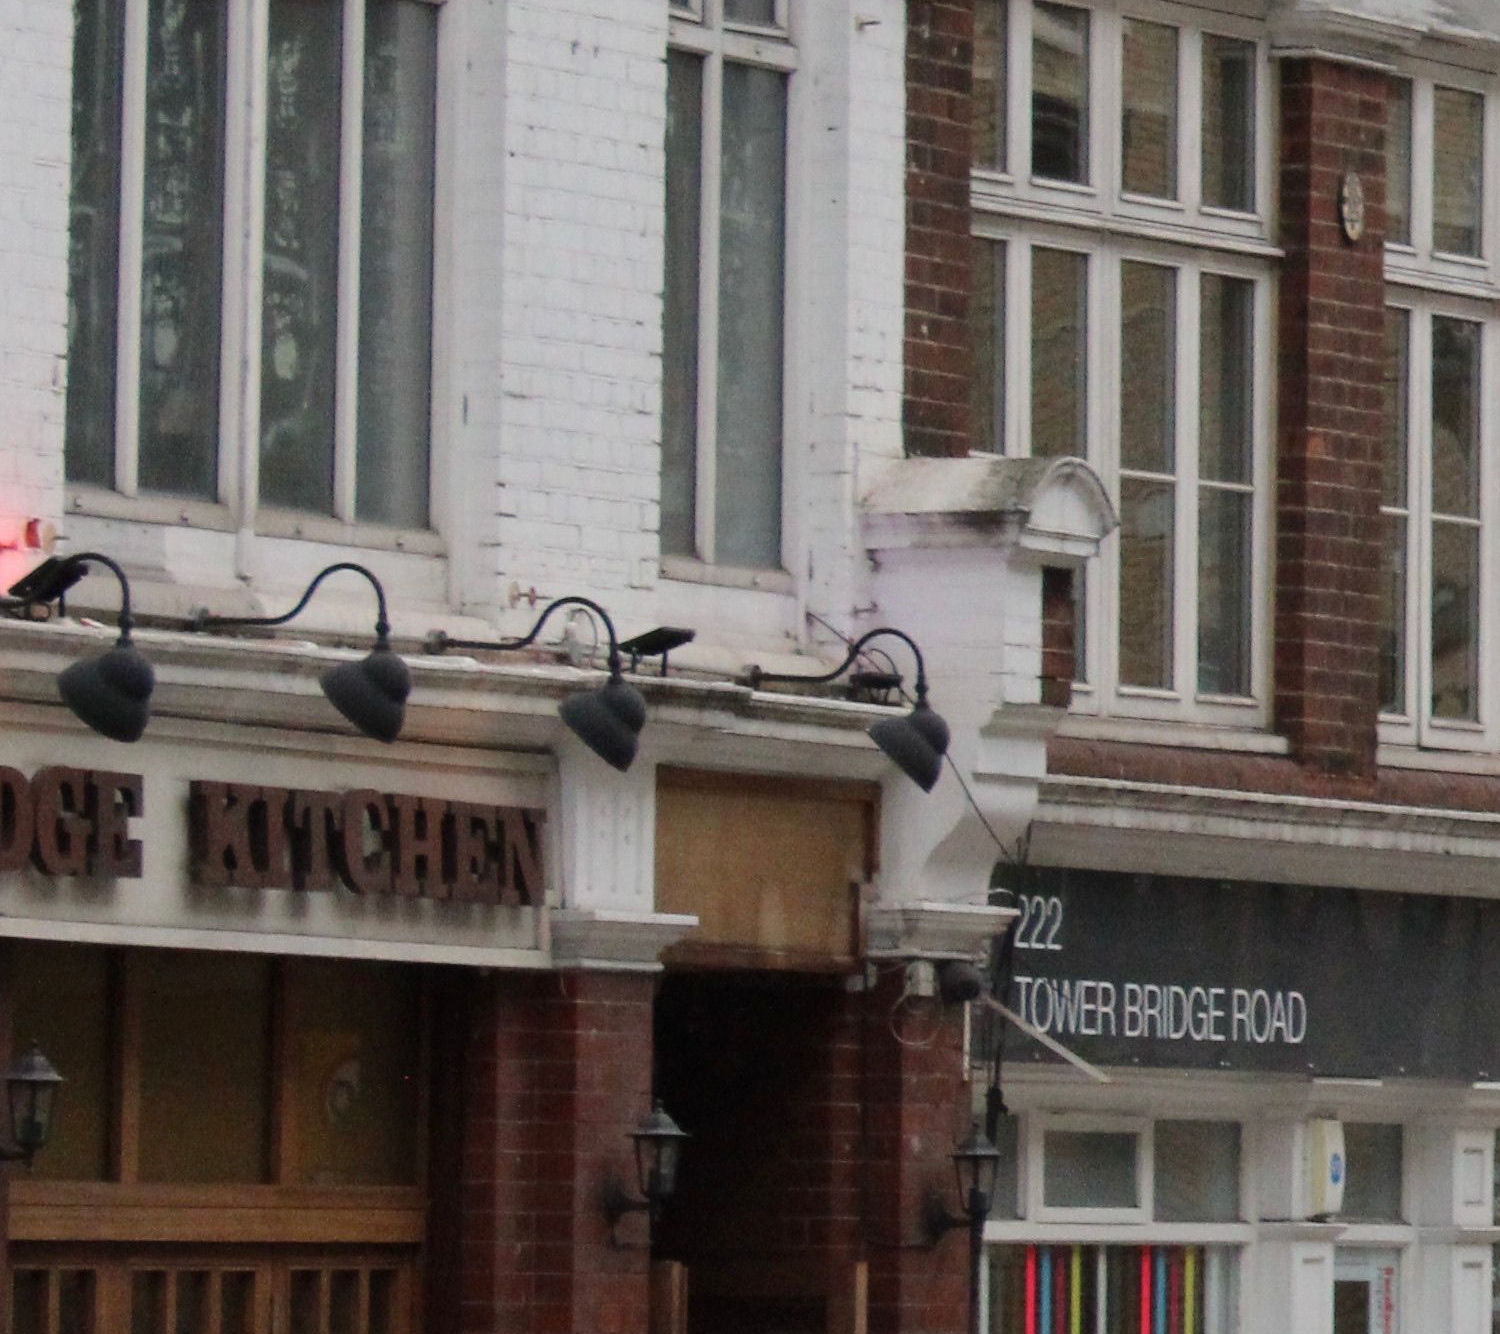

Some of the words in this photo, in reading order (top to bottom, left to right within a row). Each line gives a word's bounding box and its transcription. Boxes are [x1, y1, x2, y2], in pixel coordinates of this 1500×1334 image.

[189, 779, 547, 907] KITCHEN
[1013, 894, 1063, 951] 222
[1013, 975, 1116, 1036] TOWER
[1123, 983, 1226, 1042] BRIDGE
[1232, 988, 1307, 1044] ROAD
